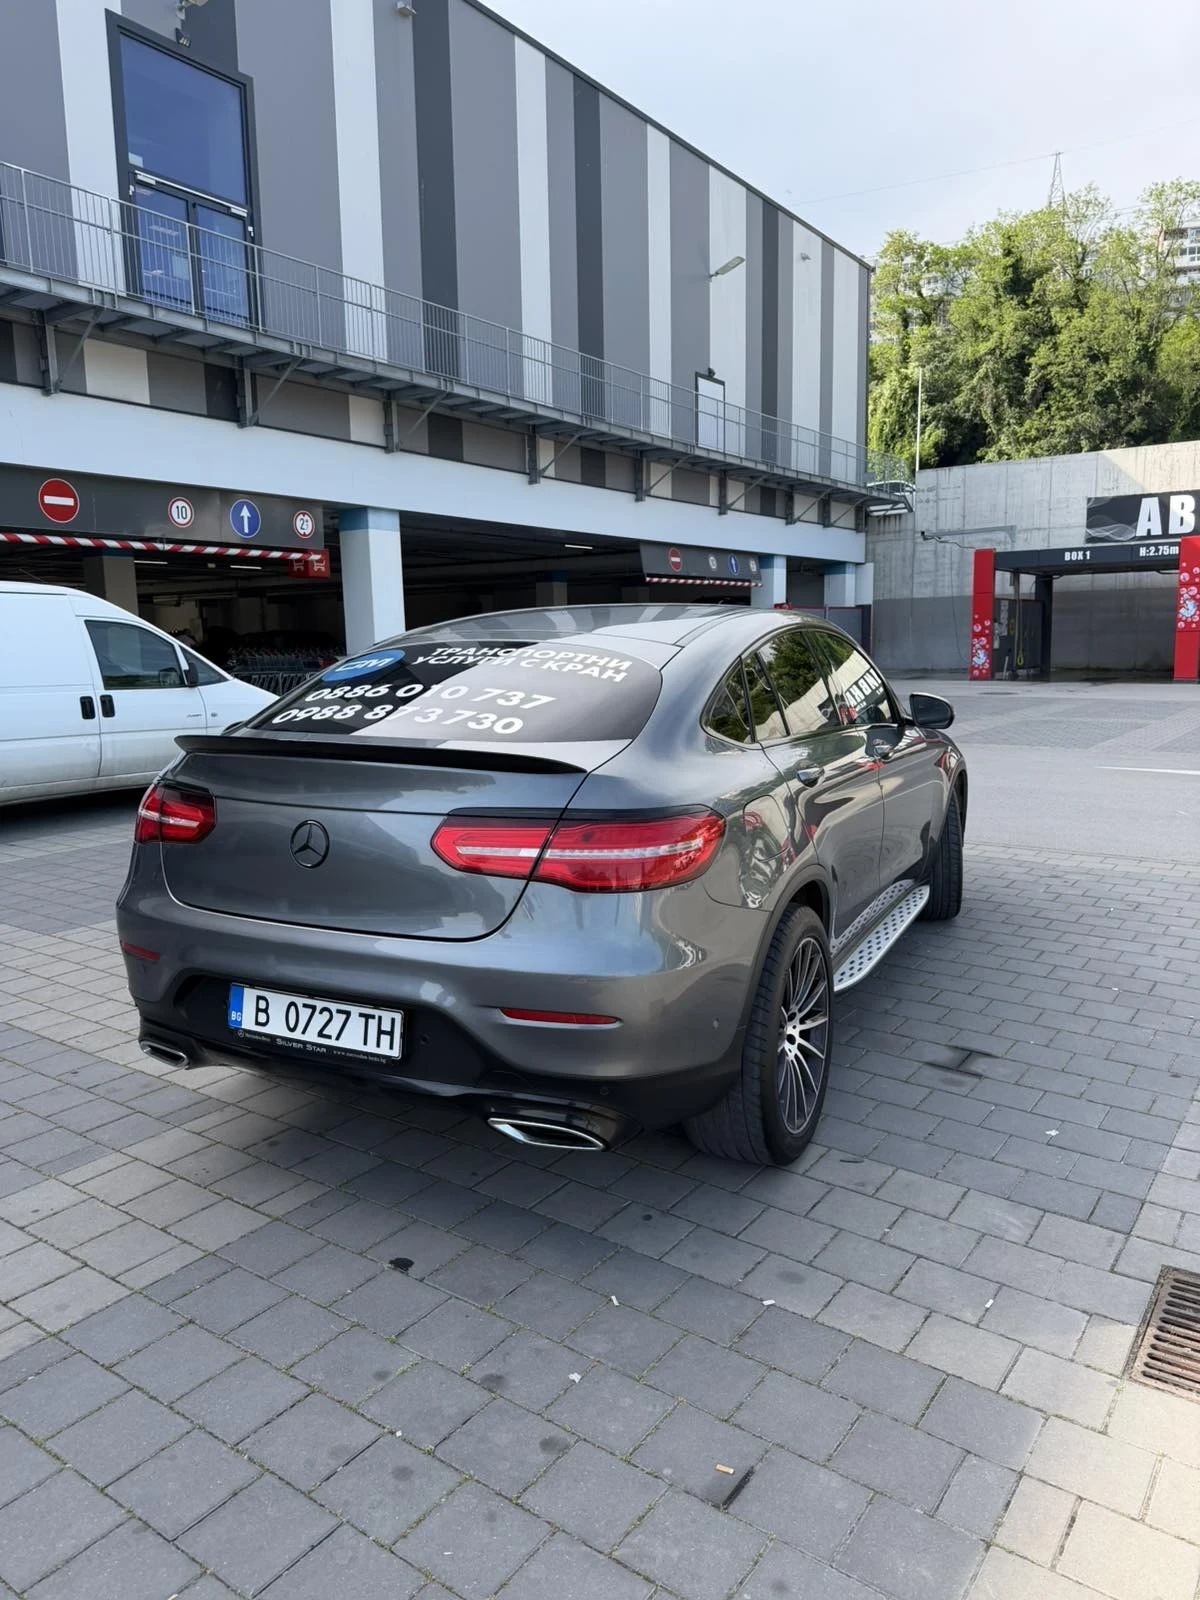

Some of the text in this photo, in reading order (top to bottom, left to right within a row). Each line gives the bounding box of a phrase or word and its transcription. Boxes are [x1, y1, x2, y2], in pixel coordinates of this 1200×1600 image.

[176, 505, 188, 520] 10
[1064, 550, 1091, 561] BOX 1
[1139, 545, 1180, 557] H:2.75m
[411, 656, 629, 682] УСЛУГИ С КРАН
[431, 647, 633, 671] ТРАНСПОРТНИ
[304, 684, 556, 710] 0886 010 737
[271, 704, 524, 735] 0988 873 730
[231, 1010, 242, 1022] BG
[255, 995, 396, 1051] B 0727 TH
